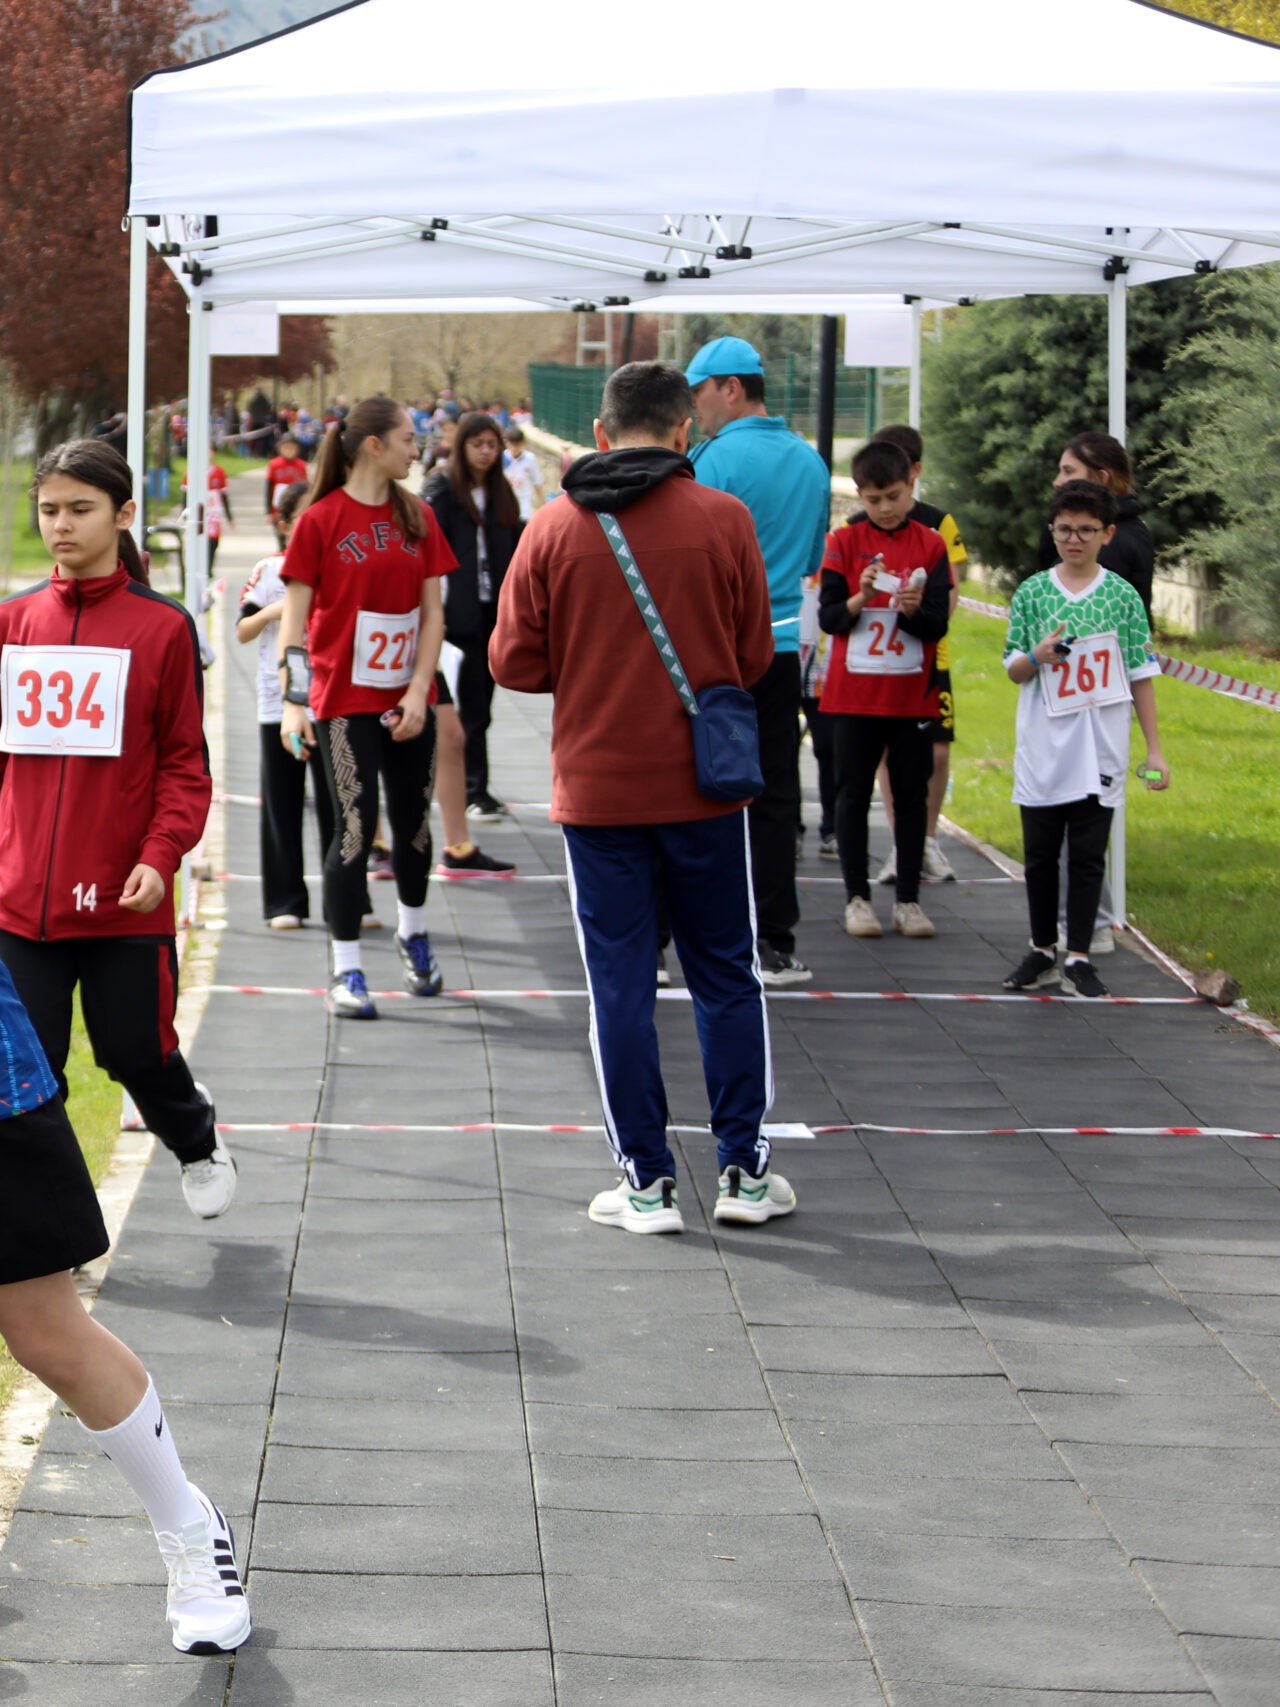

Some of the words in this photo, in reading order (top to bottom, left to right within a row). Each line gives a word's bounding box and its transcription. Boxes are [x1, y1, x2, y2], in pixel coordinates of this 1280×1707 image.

[1051, 649, 1111, 698] 267
[16, 670, 105, 729] 334
[72, 883, 97, 911] 14
